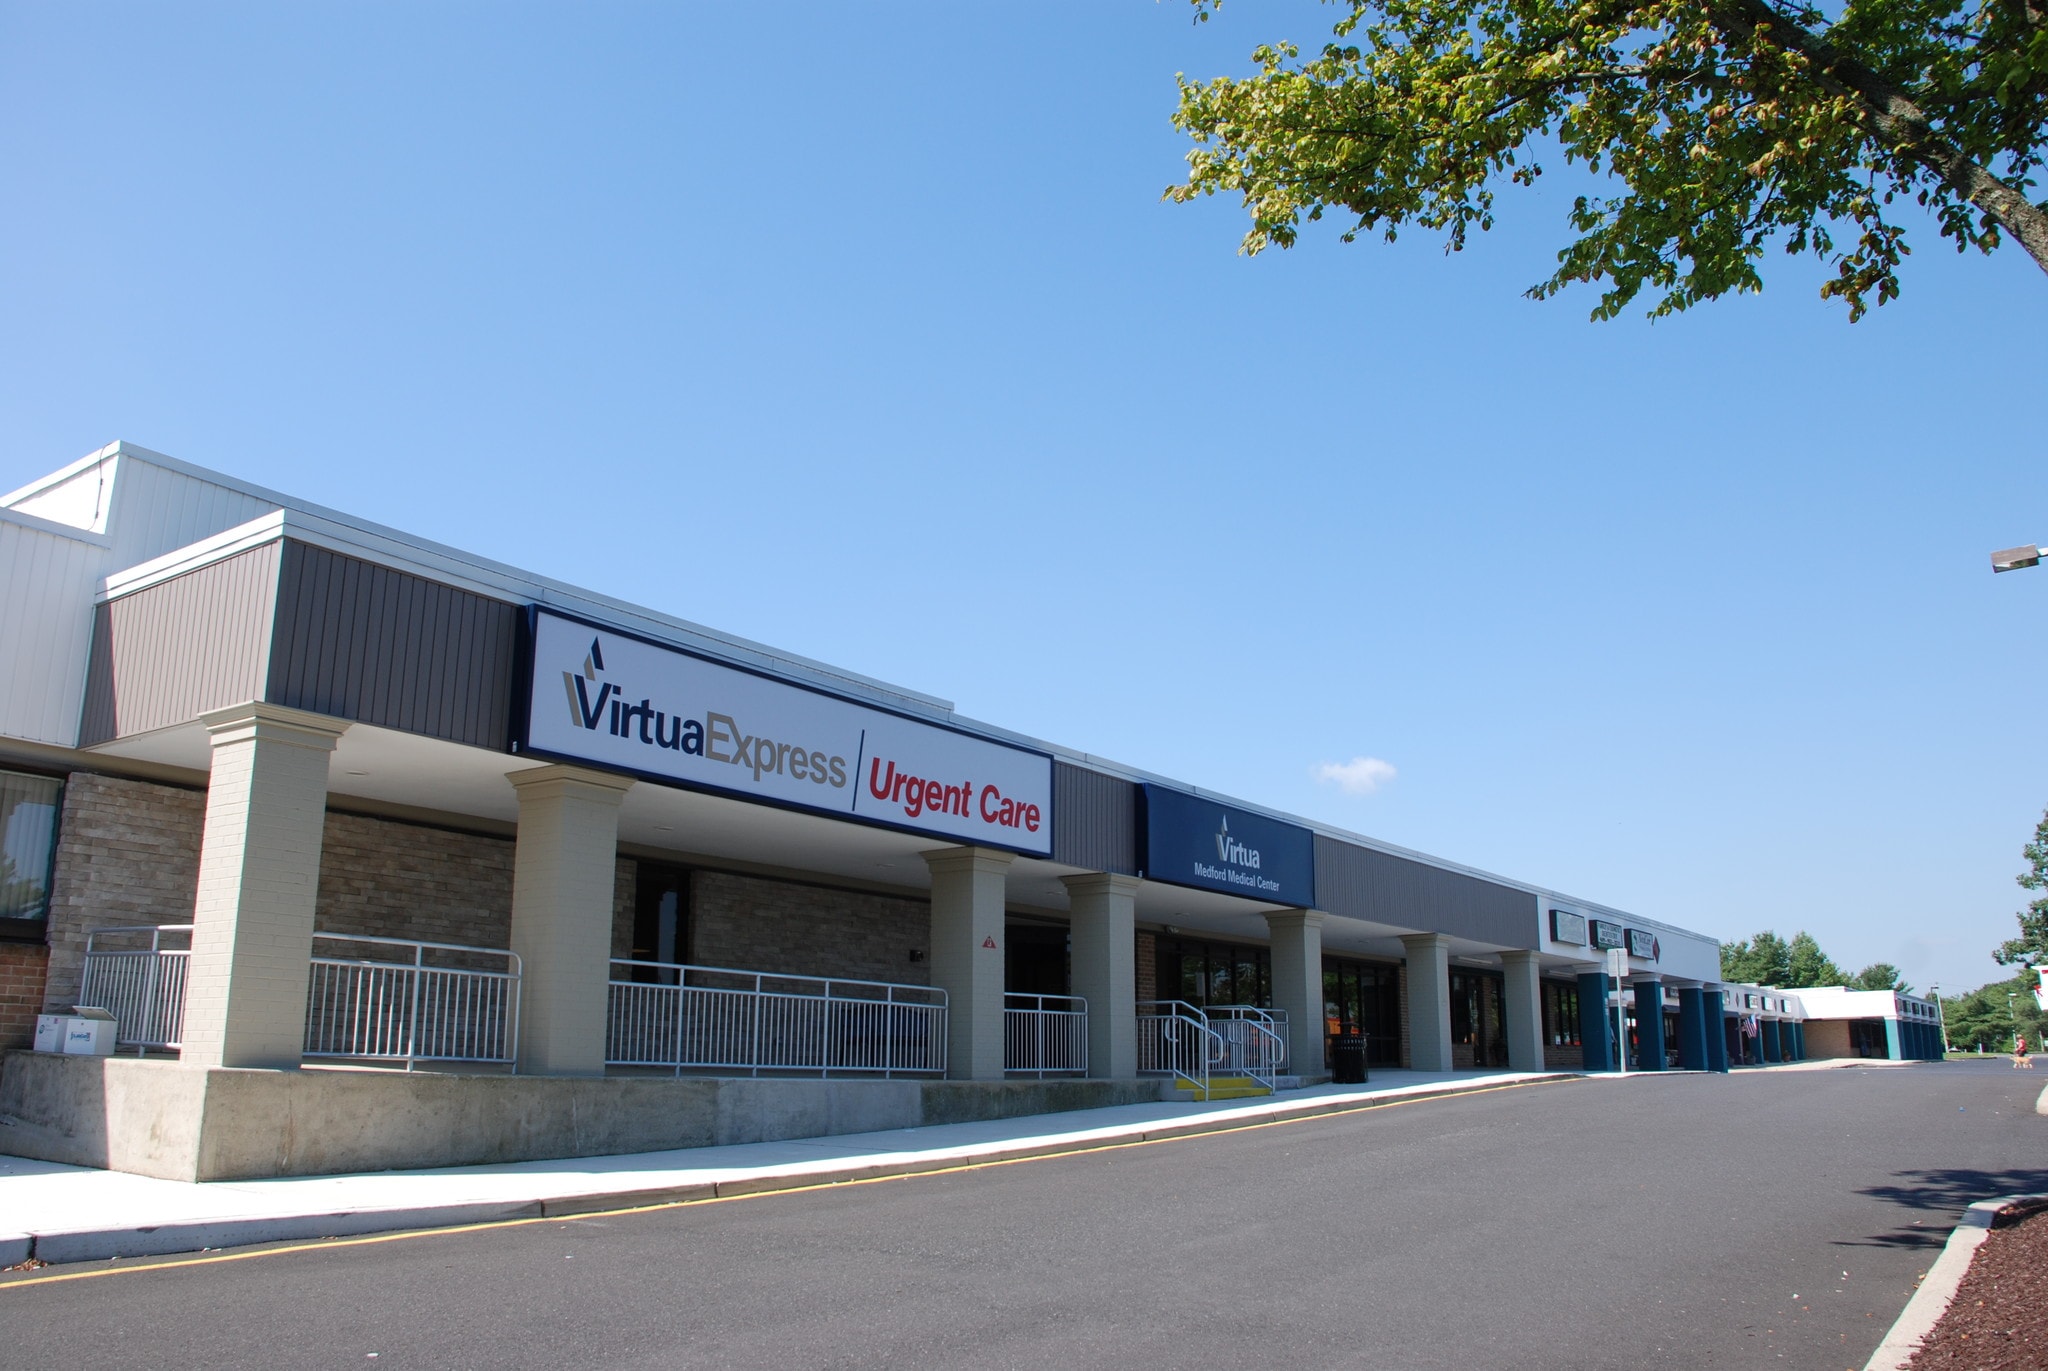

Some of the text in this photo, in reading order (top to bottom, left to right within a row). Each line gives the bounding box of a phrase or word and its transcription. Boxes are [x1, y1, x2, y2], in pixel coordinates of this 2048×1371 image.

[869, 757, 1041, 832] Urgent Care
[1217, 834, 1260, 868] Virtua
[1194, 862, 1280, 892] Medford Medical Center
